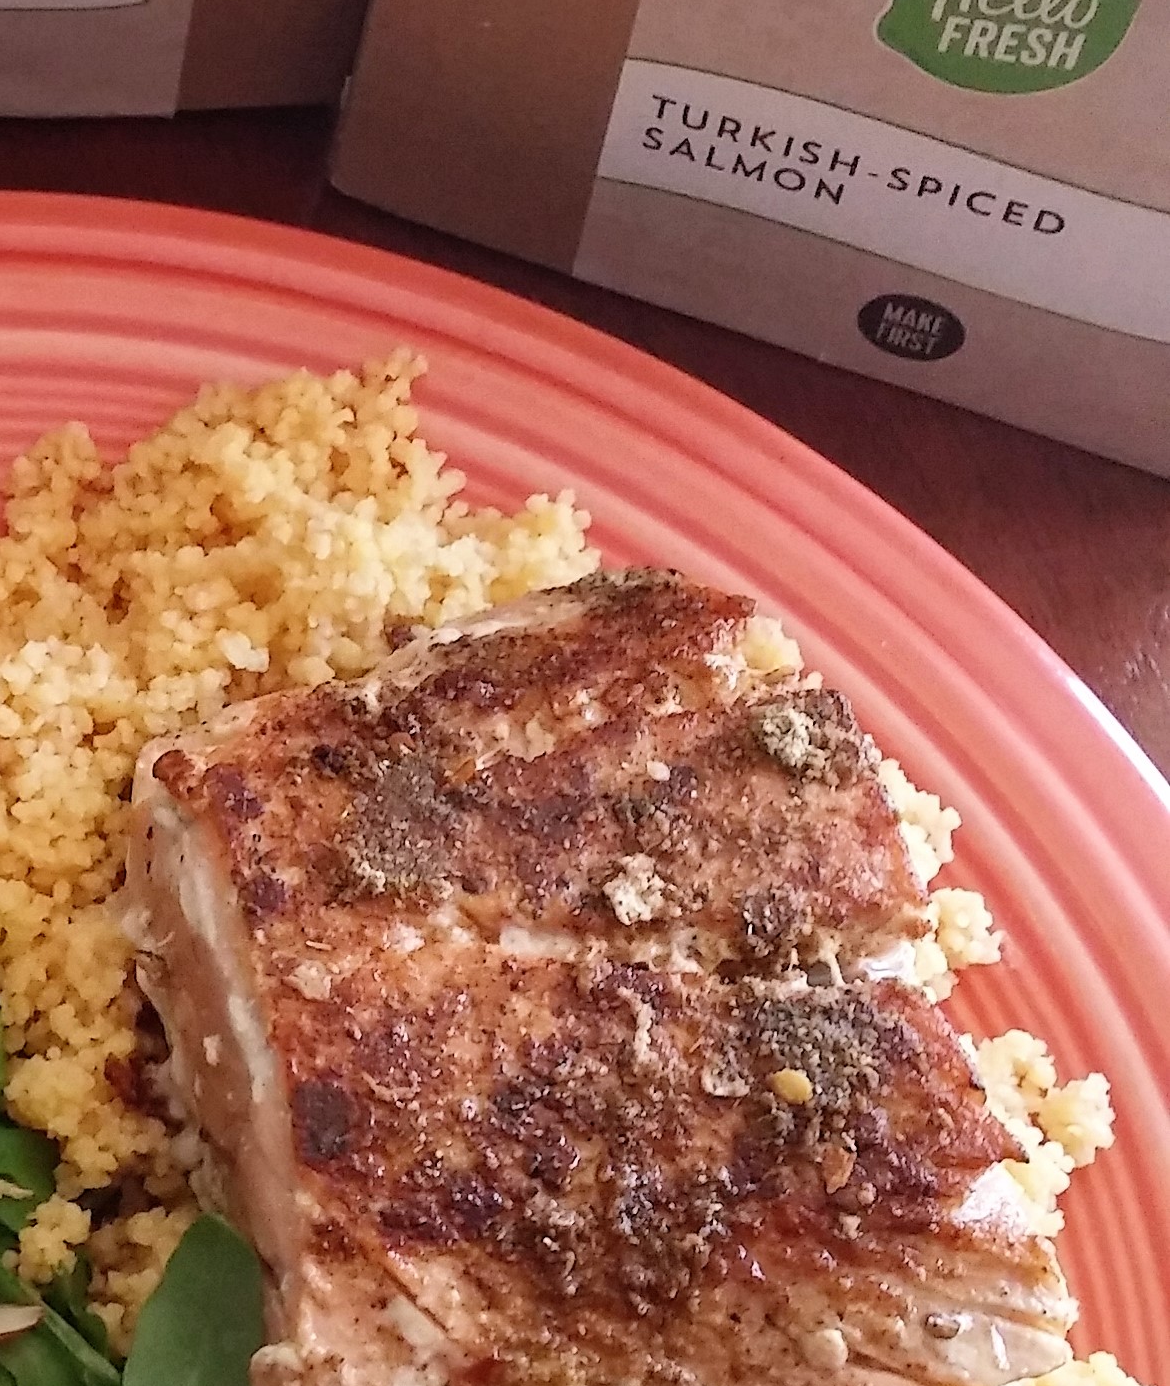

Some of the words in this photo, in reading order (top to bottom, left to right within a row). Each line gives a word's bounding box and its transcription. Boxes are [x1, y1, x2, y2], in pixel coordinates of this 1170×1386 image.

[937, 15, 1086, 71] FRESH
[642, 126, 845, 206] SALMON
[652, 94, 1066, 236] TURKISH-SPICED
[875, 321, 939, 355] FIRST
[883, 301, 944, 337] MAKE
